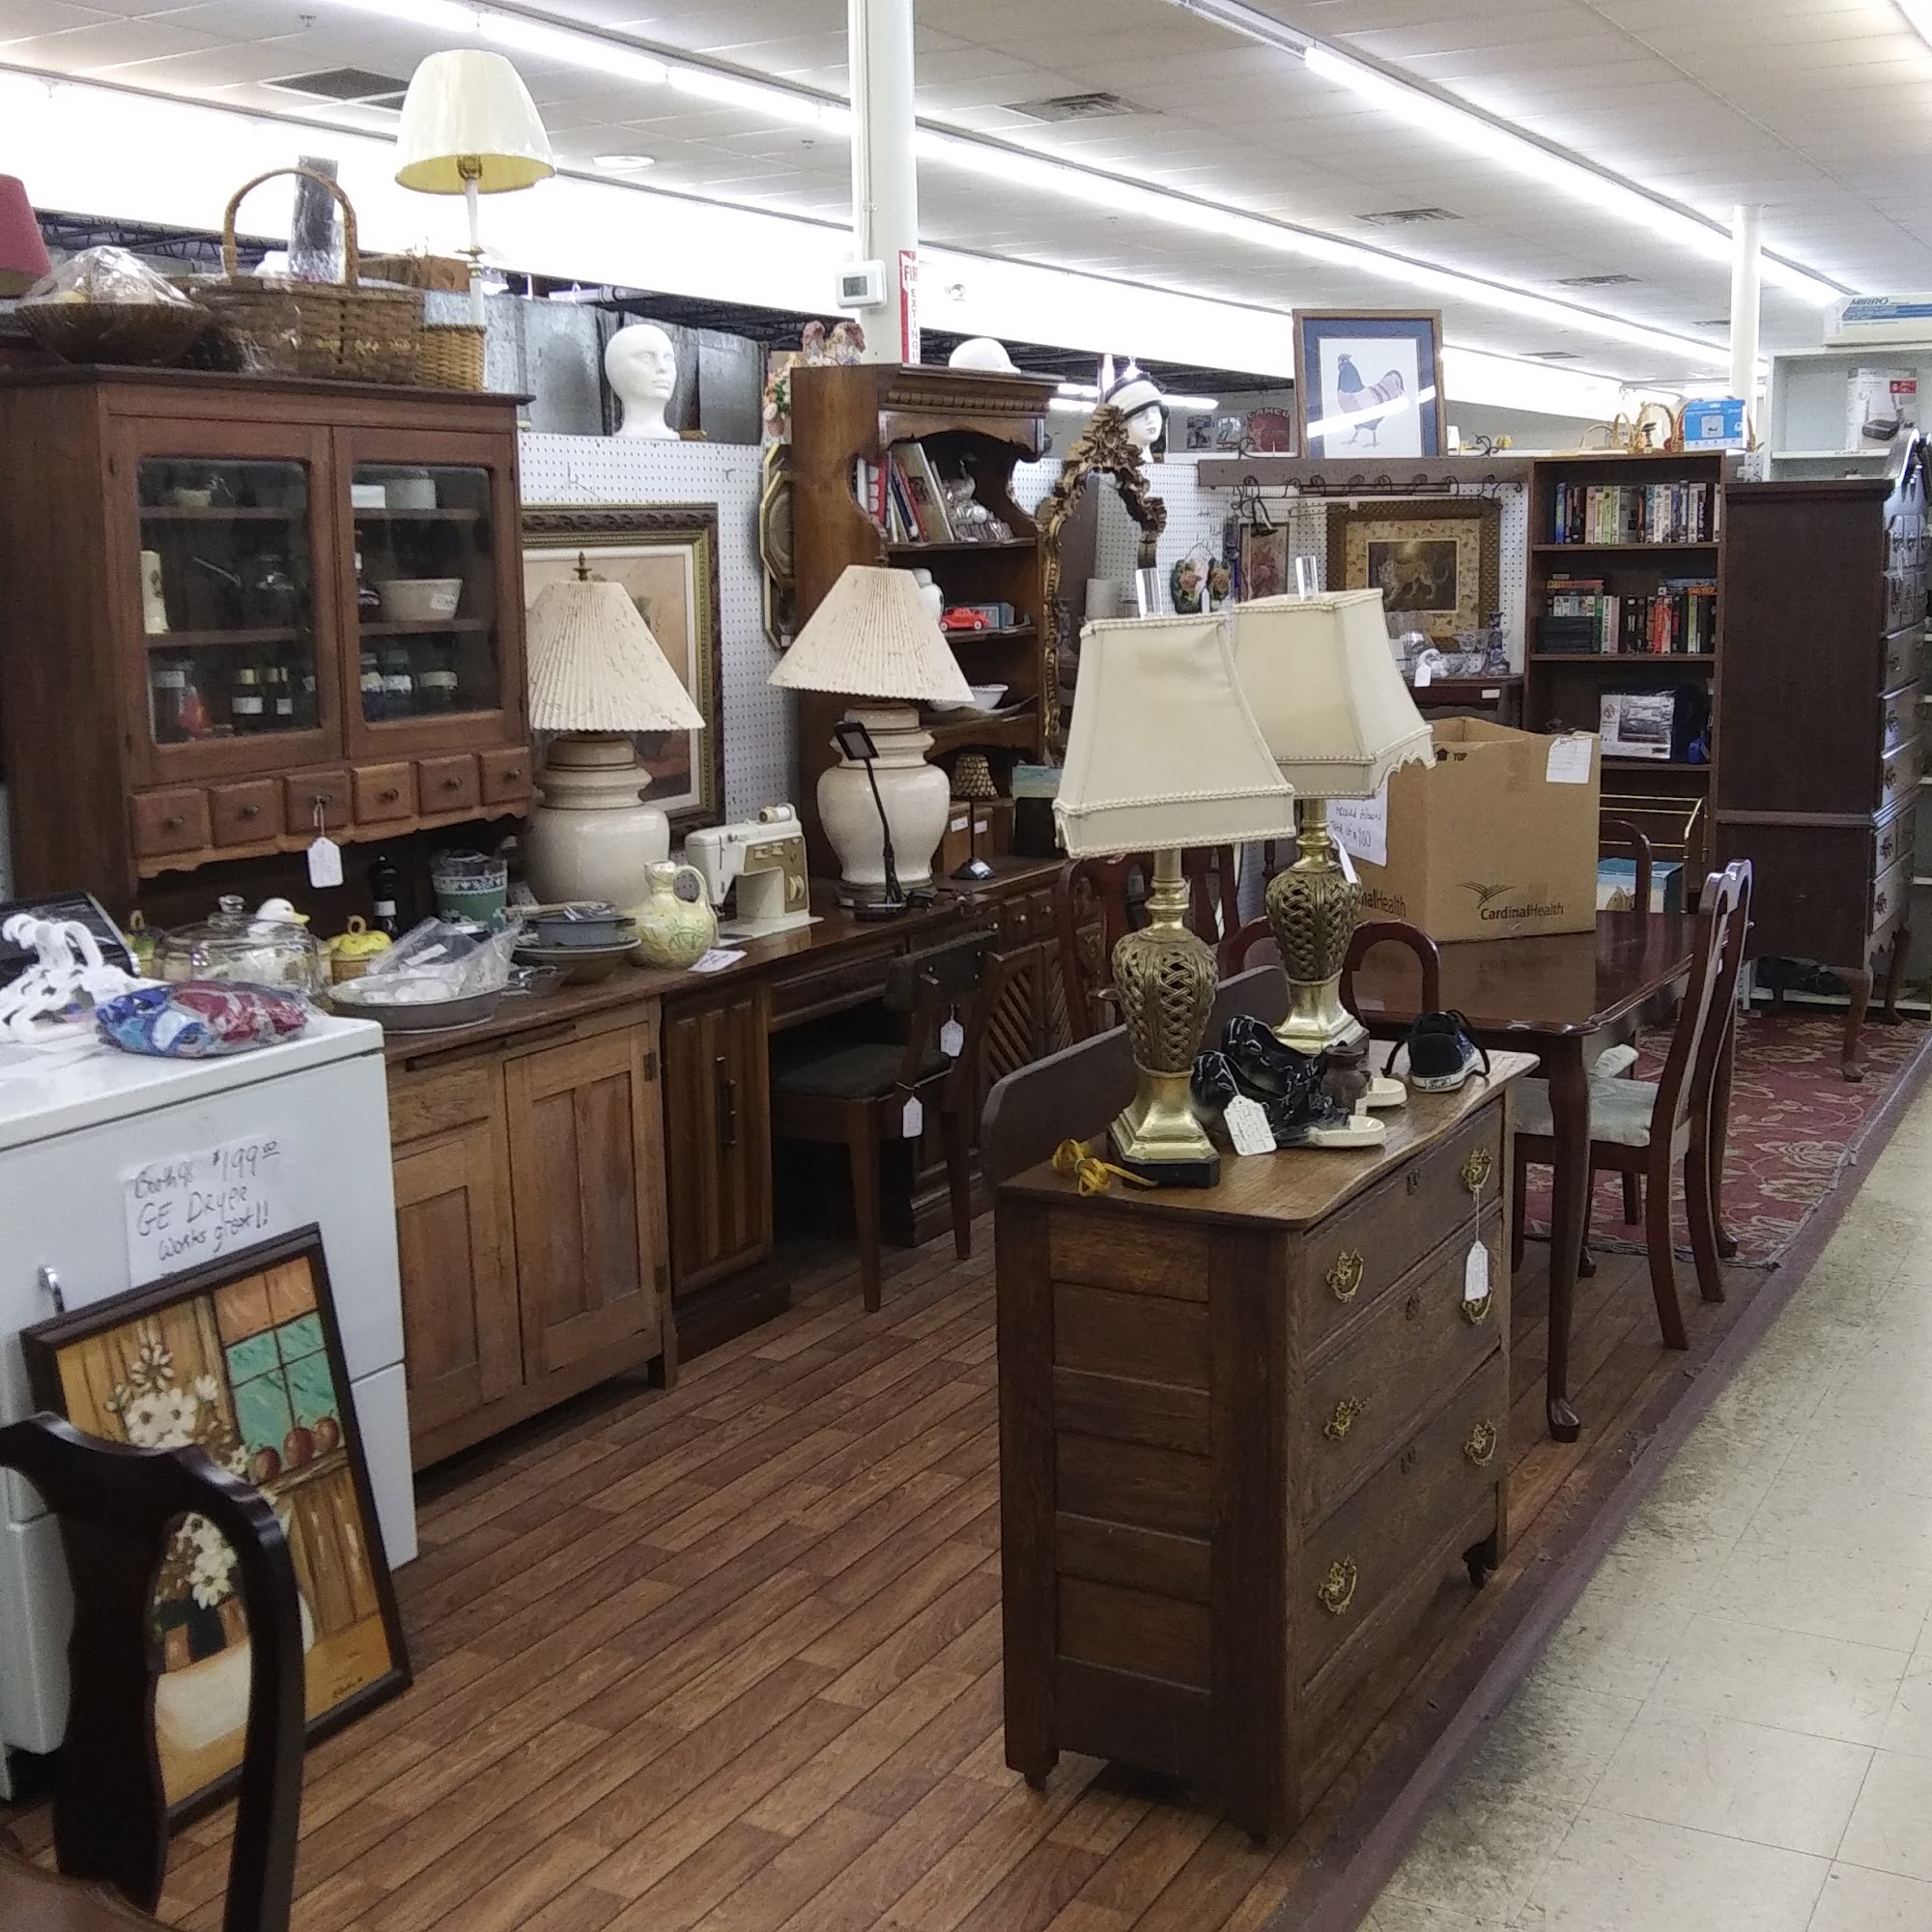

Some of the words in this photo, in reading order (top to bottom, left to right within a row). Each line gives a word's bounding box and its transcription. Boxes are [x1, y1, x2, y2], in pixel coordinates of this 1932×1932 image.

[904, 265, 918, 282] FIR
[1849, 297, 1889, 306] MIRRO
[910, 288, 920, 366] EXTINGU
[1247, 407, 1291, 418] CAMEL
[1453, 752, 1467, 763] TOP
[1361, 888, 1406, 918] nalHealth
[1480, 903, 1564, 921] CardinalHealth
[137, 1202, 173, 1236] GE
